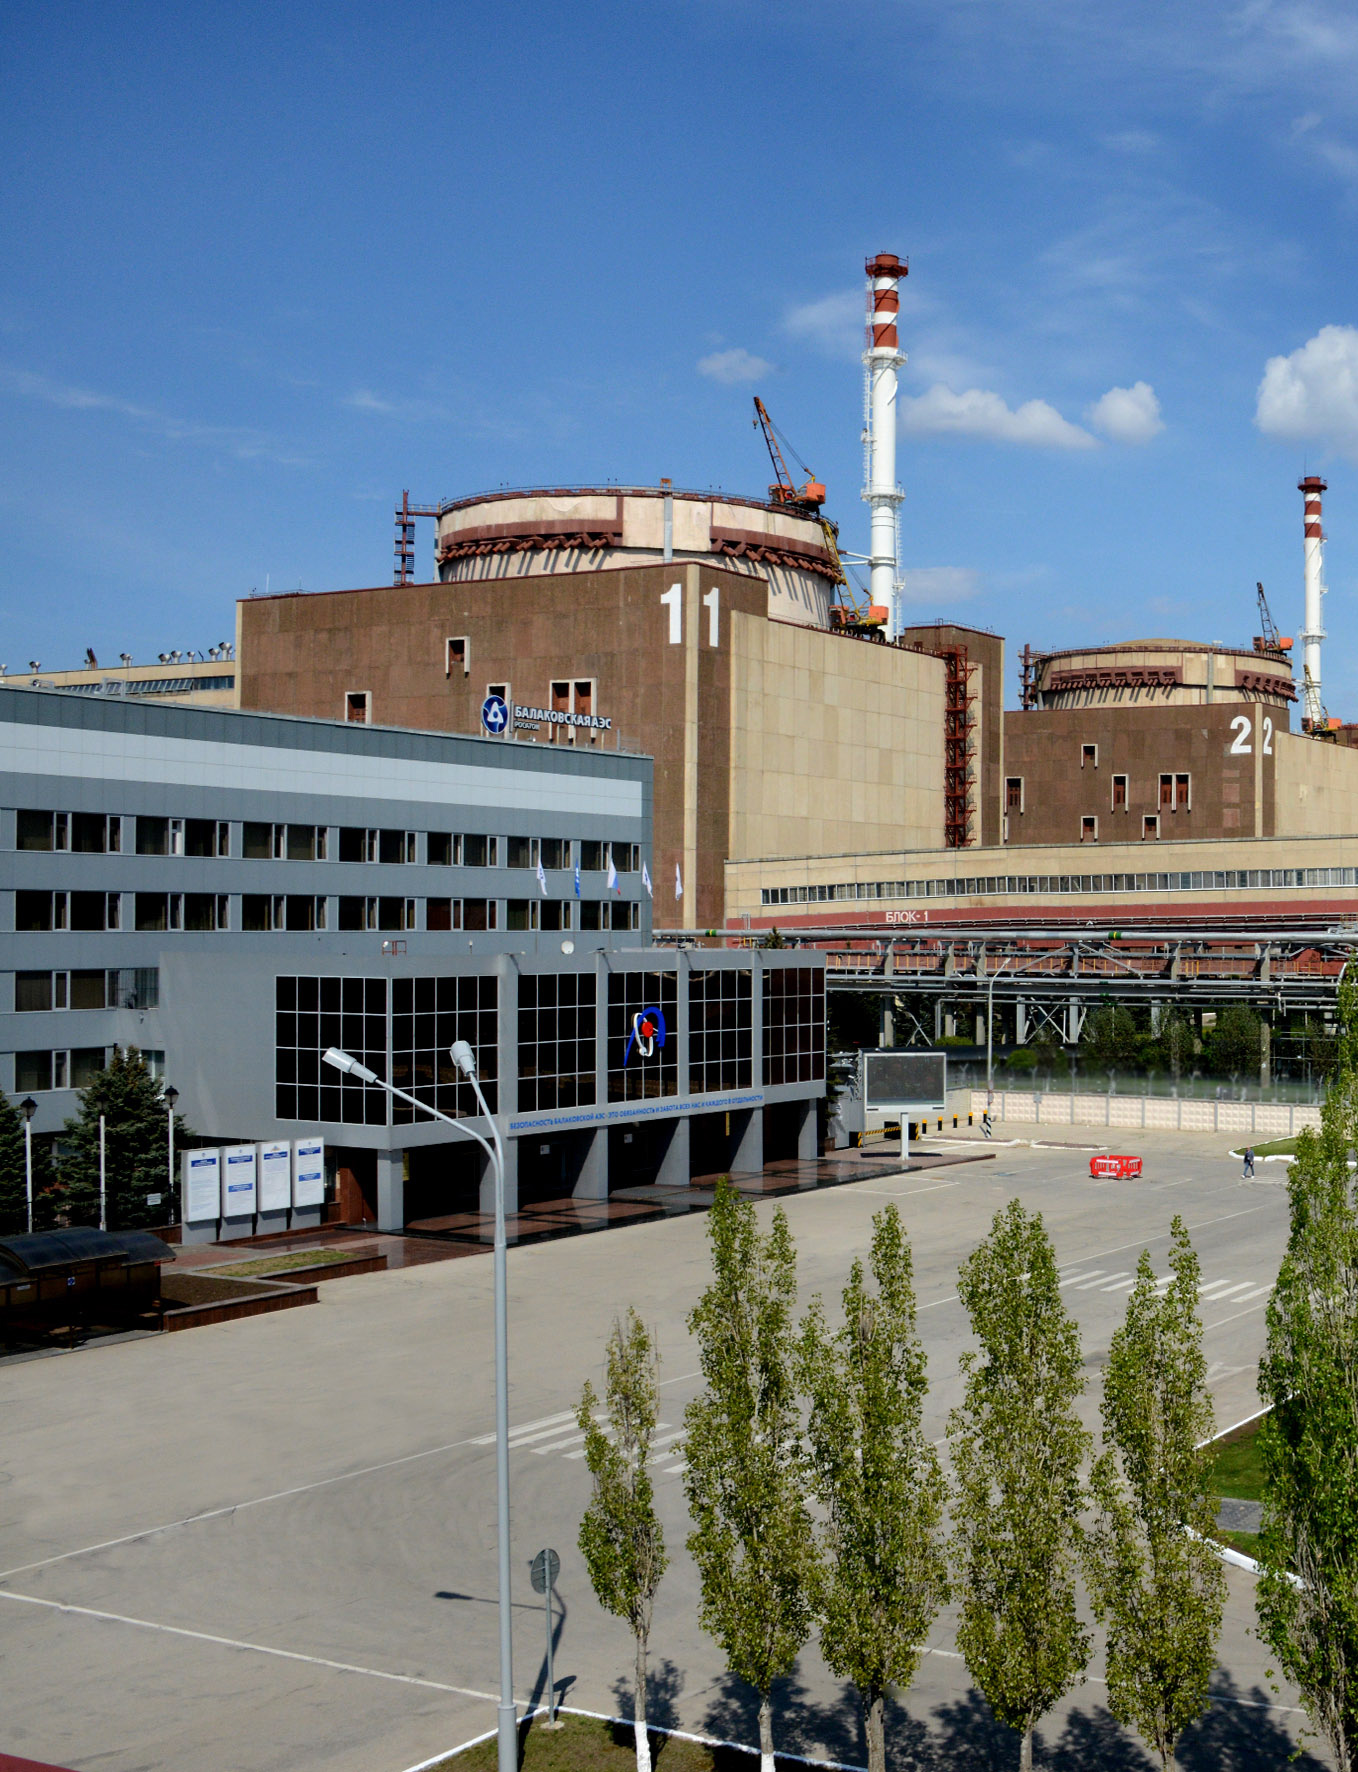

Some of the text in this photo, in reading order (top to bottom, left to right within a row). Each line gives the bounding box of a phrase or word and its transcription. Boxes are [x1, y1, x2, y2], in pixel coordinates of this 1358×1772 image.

[660, 583, 682, 644] 1
[703, 587, 719, 647] 1
[515, 706, 612, 729] БАЛАКОВСКАЯ АЭС
[1230, 715, 1252, 754] 2
[1263, 716, 1273, 755] 2
